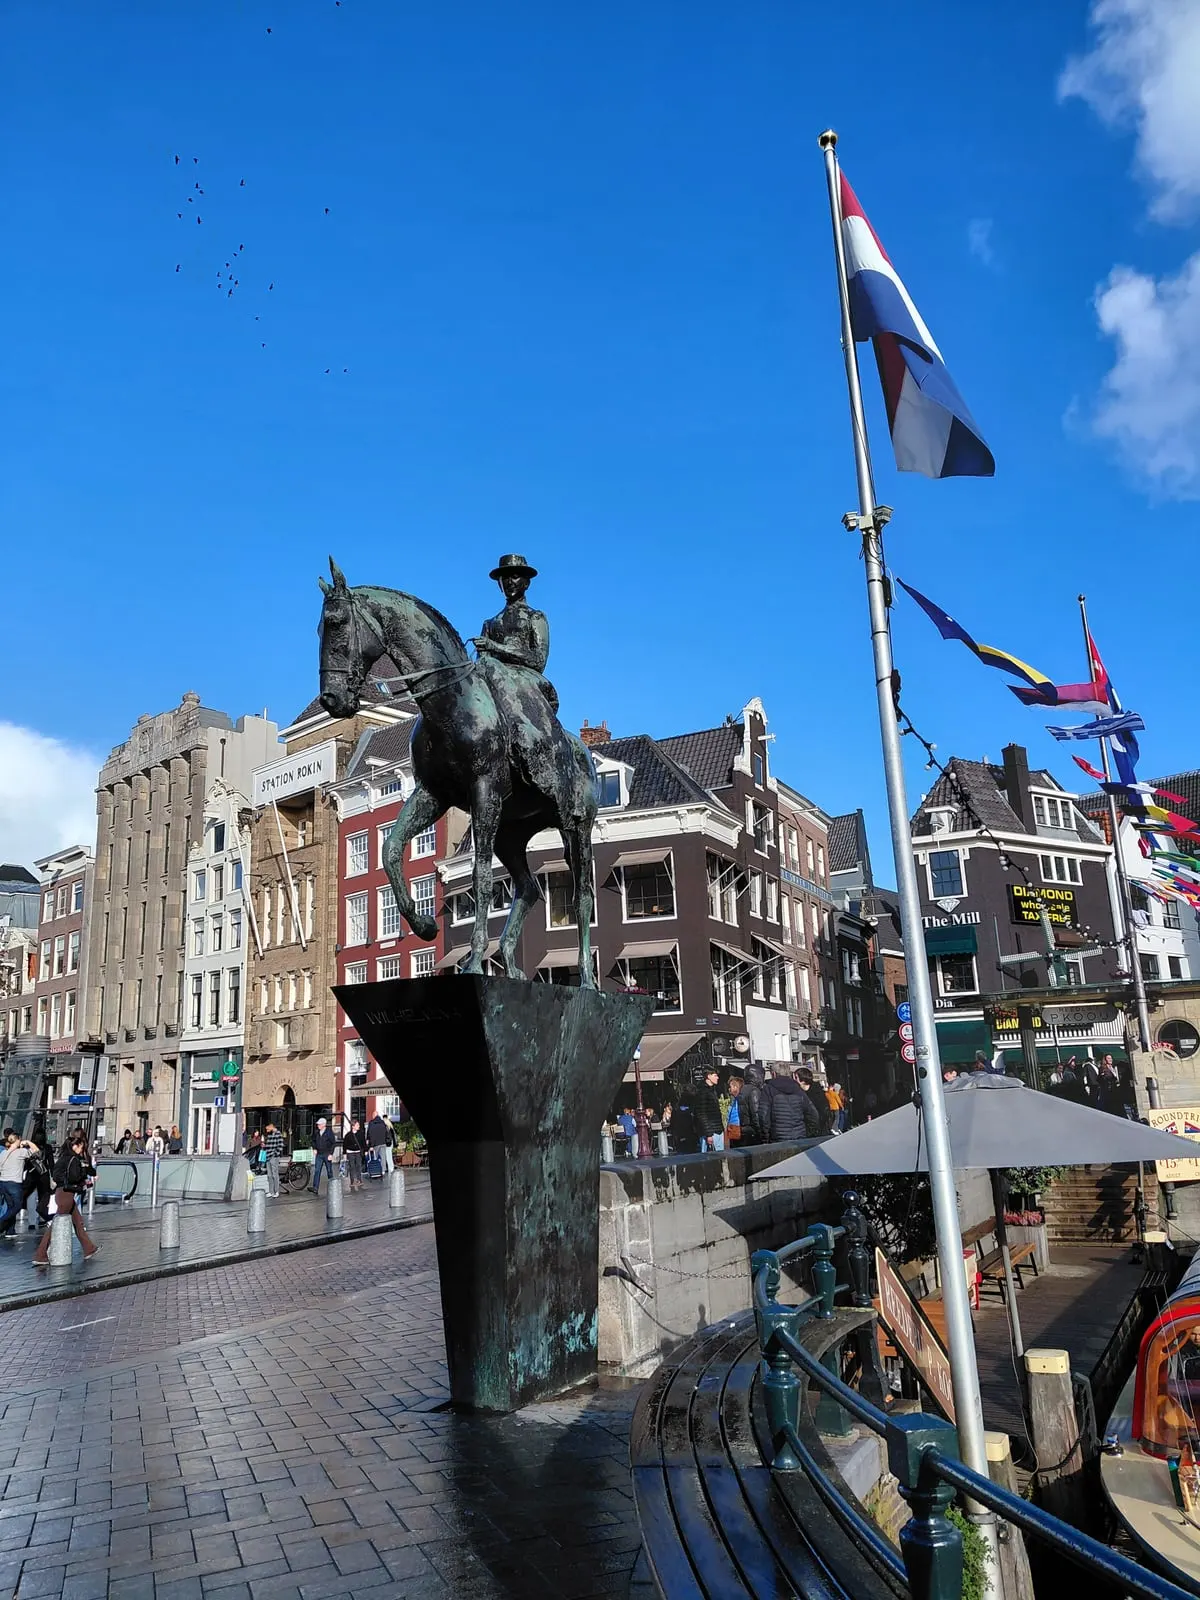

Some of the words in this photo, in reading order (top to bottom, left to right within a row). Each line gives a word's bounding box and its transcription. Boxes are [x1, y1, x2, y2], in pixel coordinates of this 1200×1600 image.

[261, 771, 294, 792] STATION
[297, 760, 322, 779] ROKIN
[922, 916, 948, 928] The
[952, 912, 981, 925] Mill
[1151, 1111, 1200, 1127] ROUNDTRI
